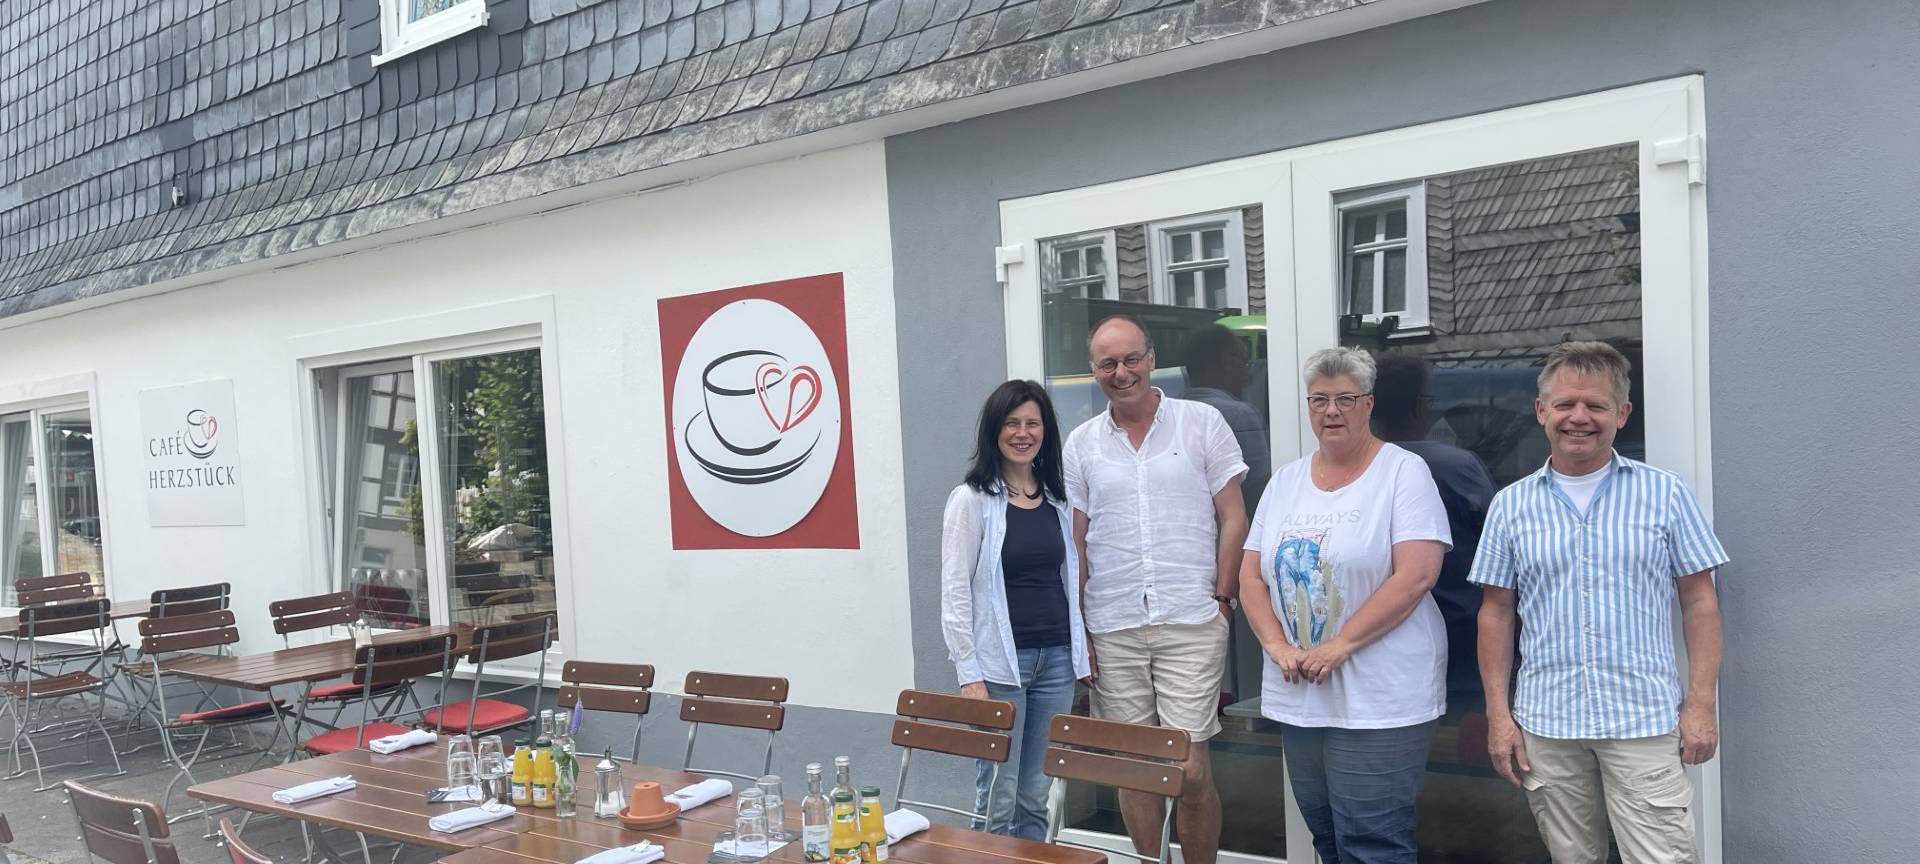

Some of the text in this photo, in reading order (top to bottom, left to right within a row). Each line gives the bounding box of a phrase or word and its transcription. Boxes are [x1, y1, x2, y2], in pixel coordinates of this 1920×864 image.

[149, 430, 183, 457] CAFÉ
[149, 462, 235, 489] HERZSTÜCK
[1281, 509, 1361, 526] ALWAYS
